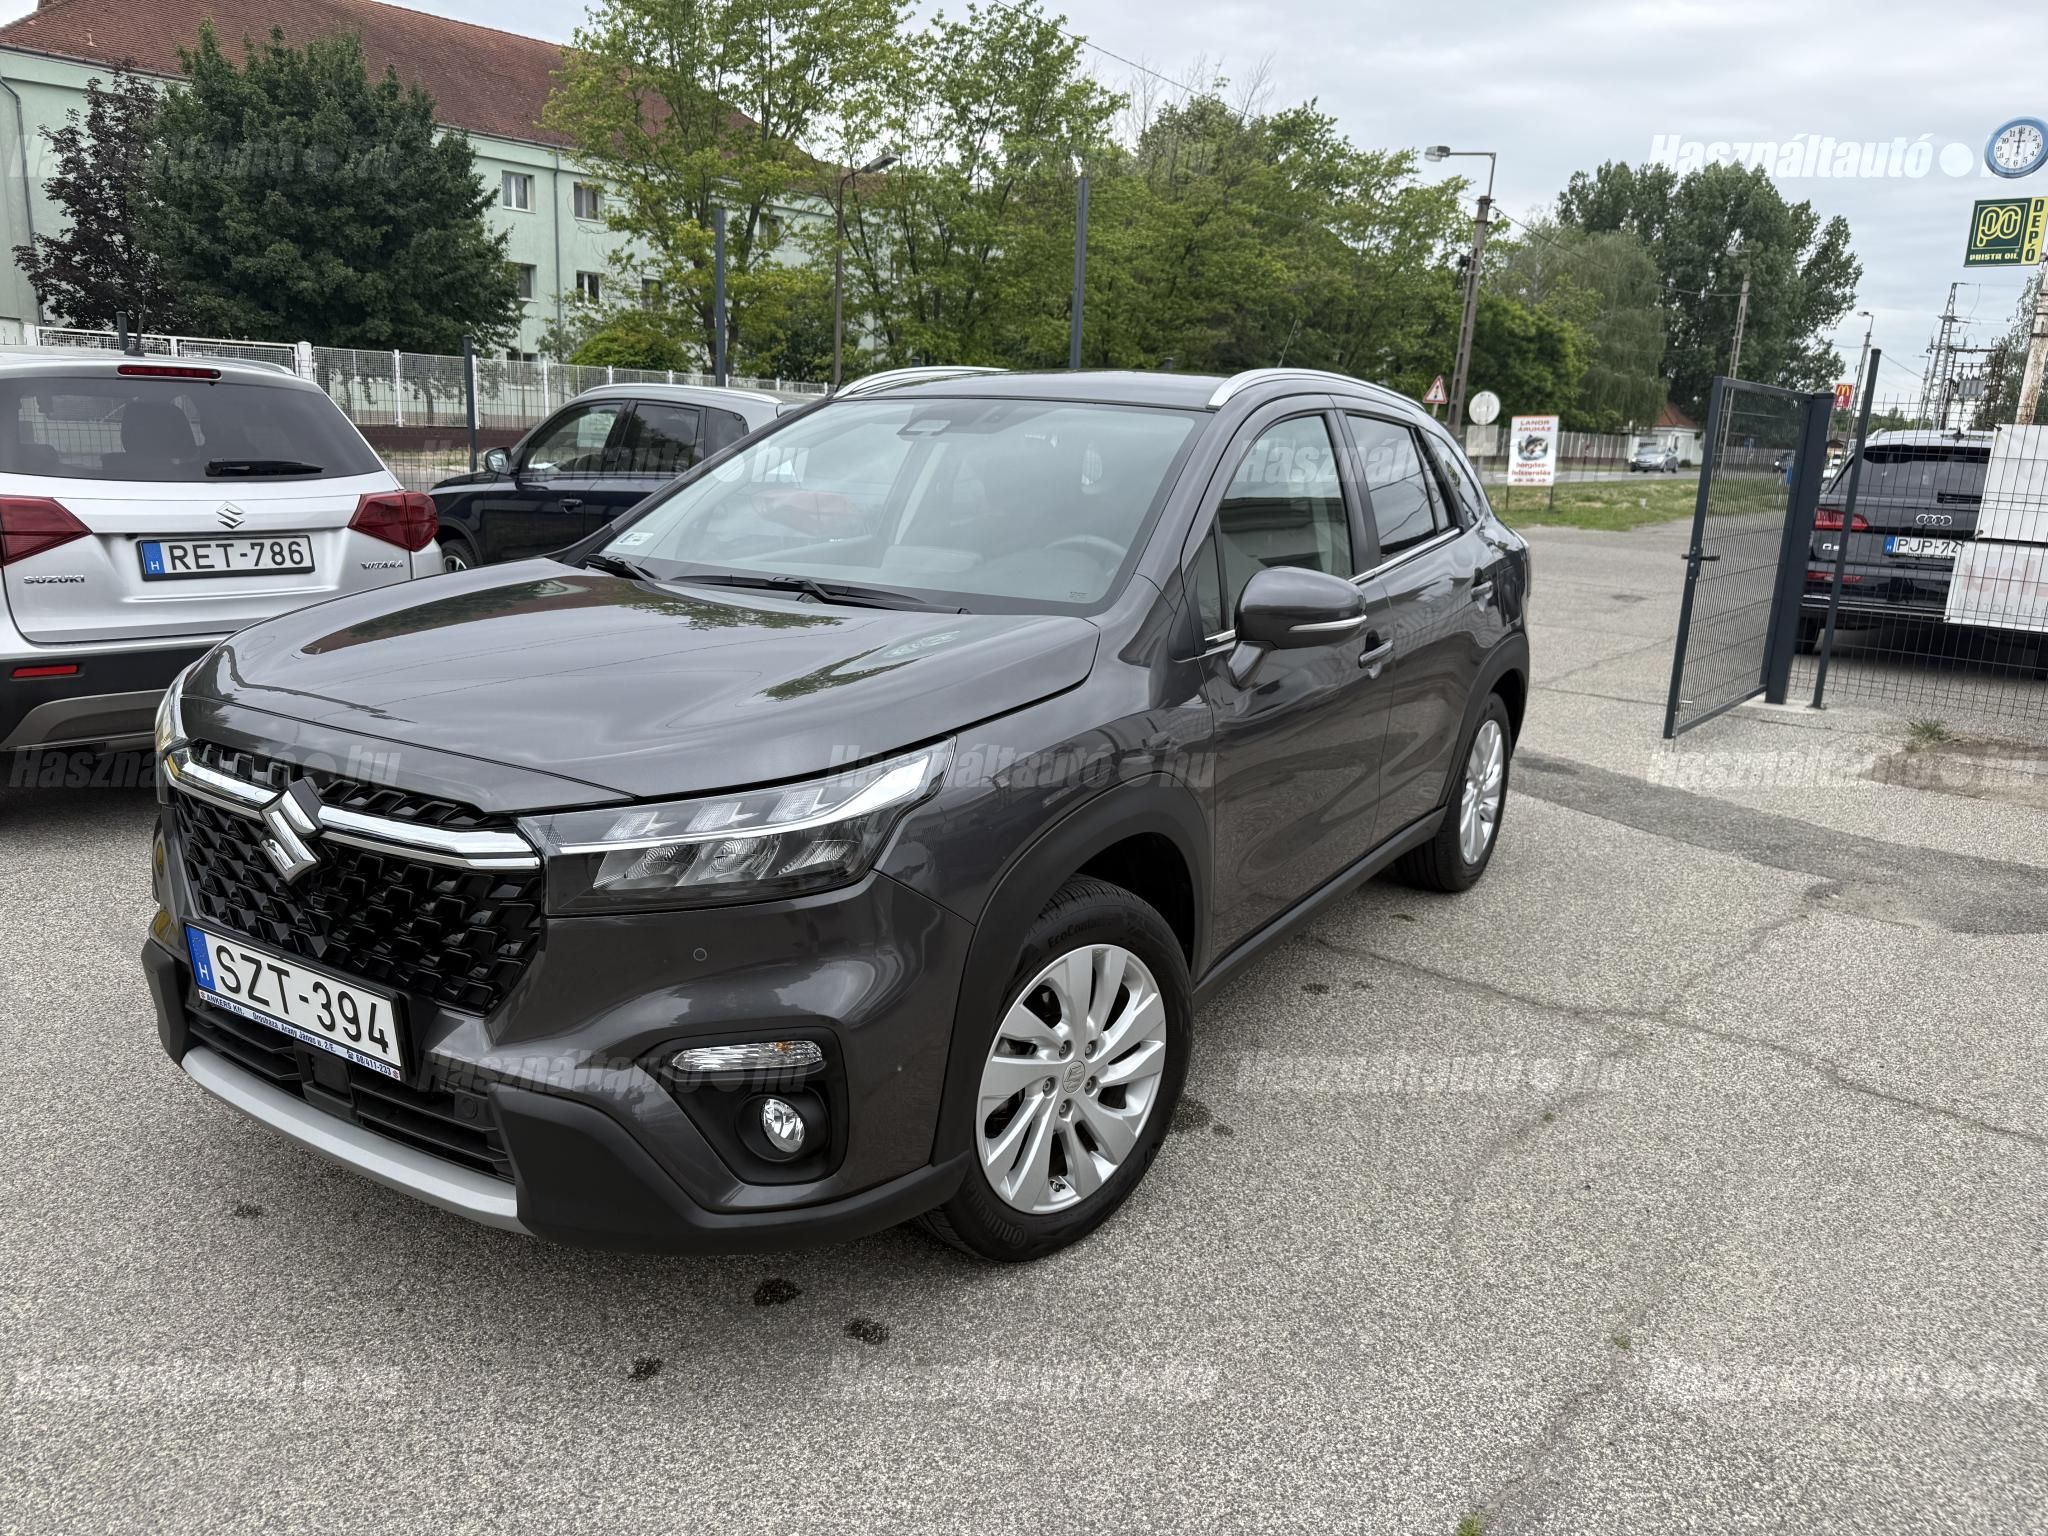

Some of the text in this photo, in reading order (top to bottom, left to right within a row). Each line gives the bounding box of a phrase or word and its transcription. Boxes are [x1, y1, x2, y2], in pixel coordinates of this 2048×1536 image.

[167, 541, 304, 570] RET-786
[150, 561, 160, 571] H
[361, 560, 404, 569] VITARA
[23, 574, 86, 585] SUZUKI
[199, 962, 210, 981] H
[215, 944, 389, 1054] SZT-394
